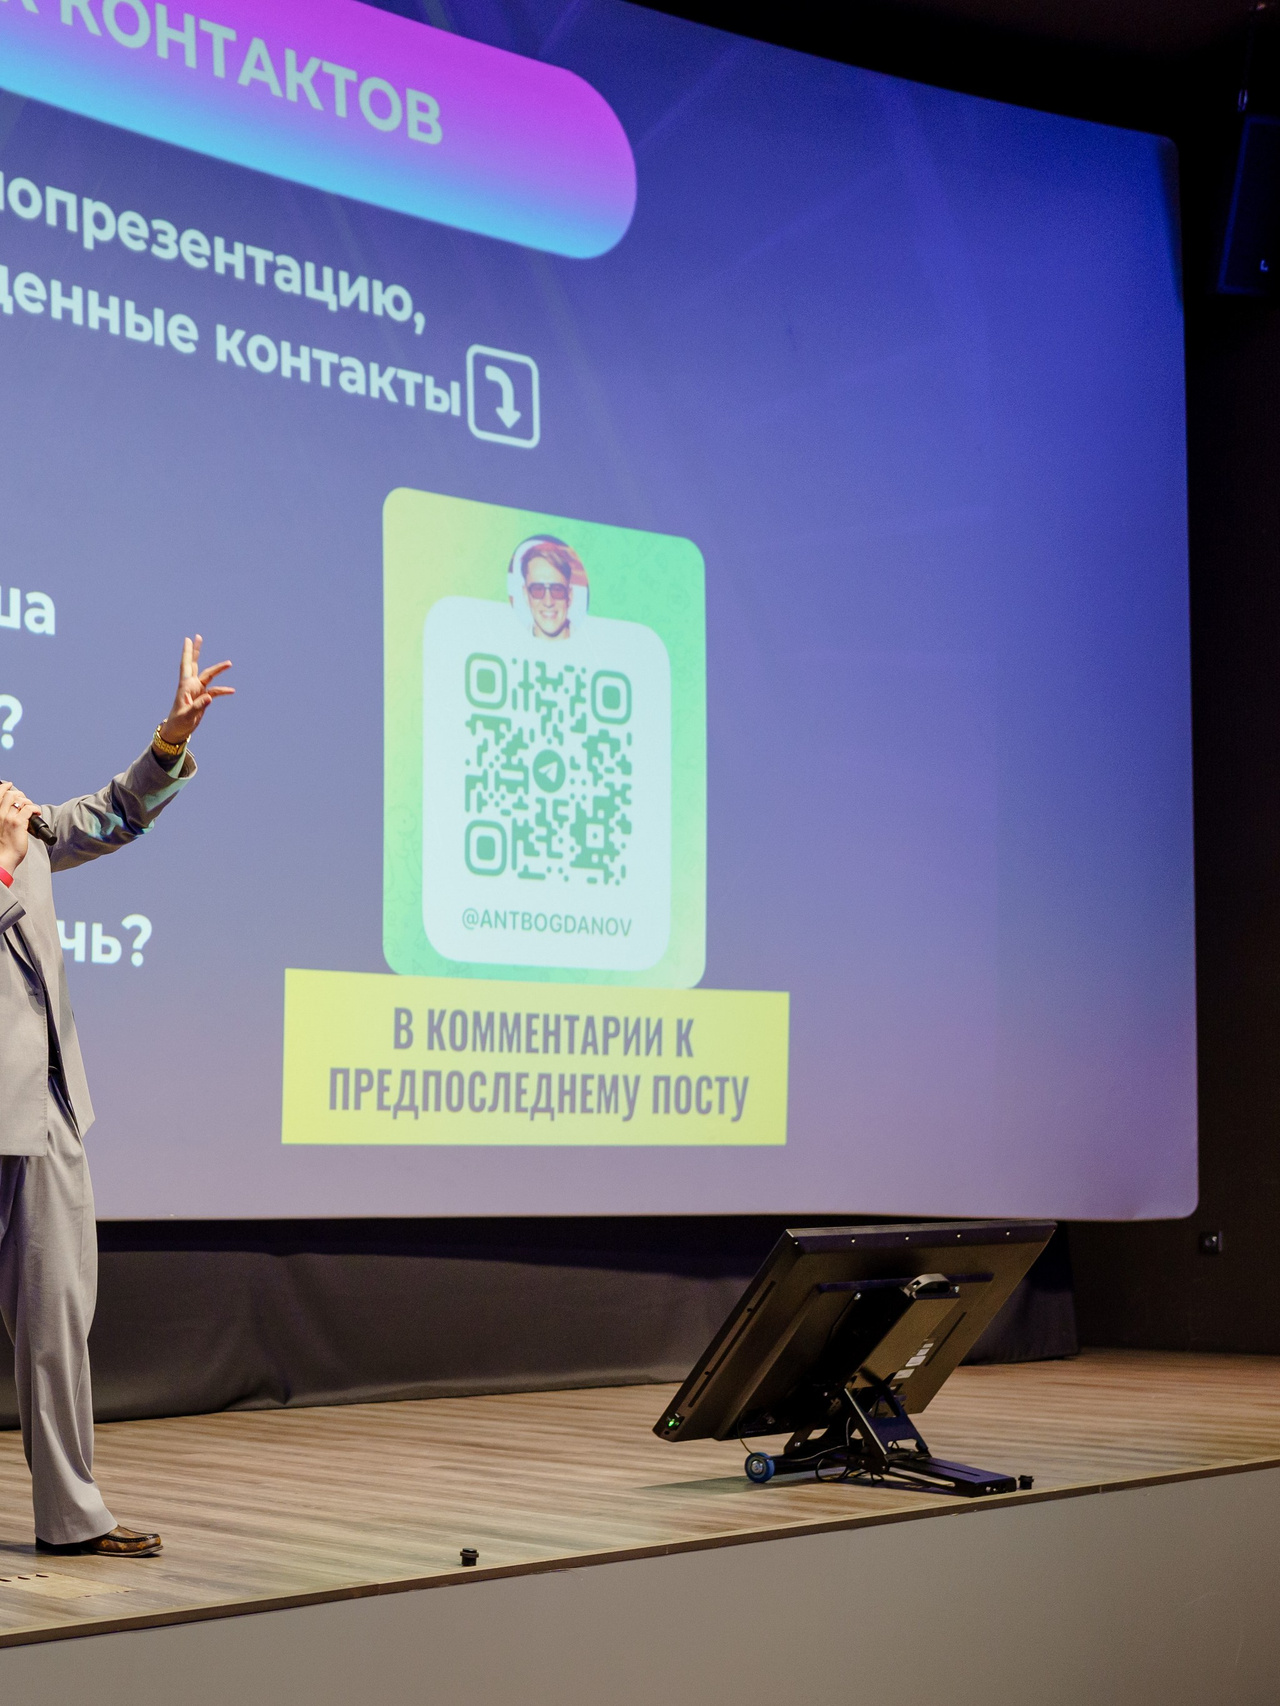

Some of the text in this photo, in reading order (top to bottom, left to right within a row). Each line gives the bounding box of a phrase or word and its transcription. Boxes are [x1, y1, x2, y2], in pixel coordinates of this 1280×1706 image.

[215, 324, 462, 417] контакты
[462, 907, 632, 937] @ANTBOGDANOV
[393, 1007, 695, 1057] В КОММЕНТАРИИ К
[329, 1067, 749, 1122] ПРЕДПОСЛЕДНЕМУ ПОСТУ
